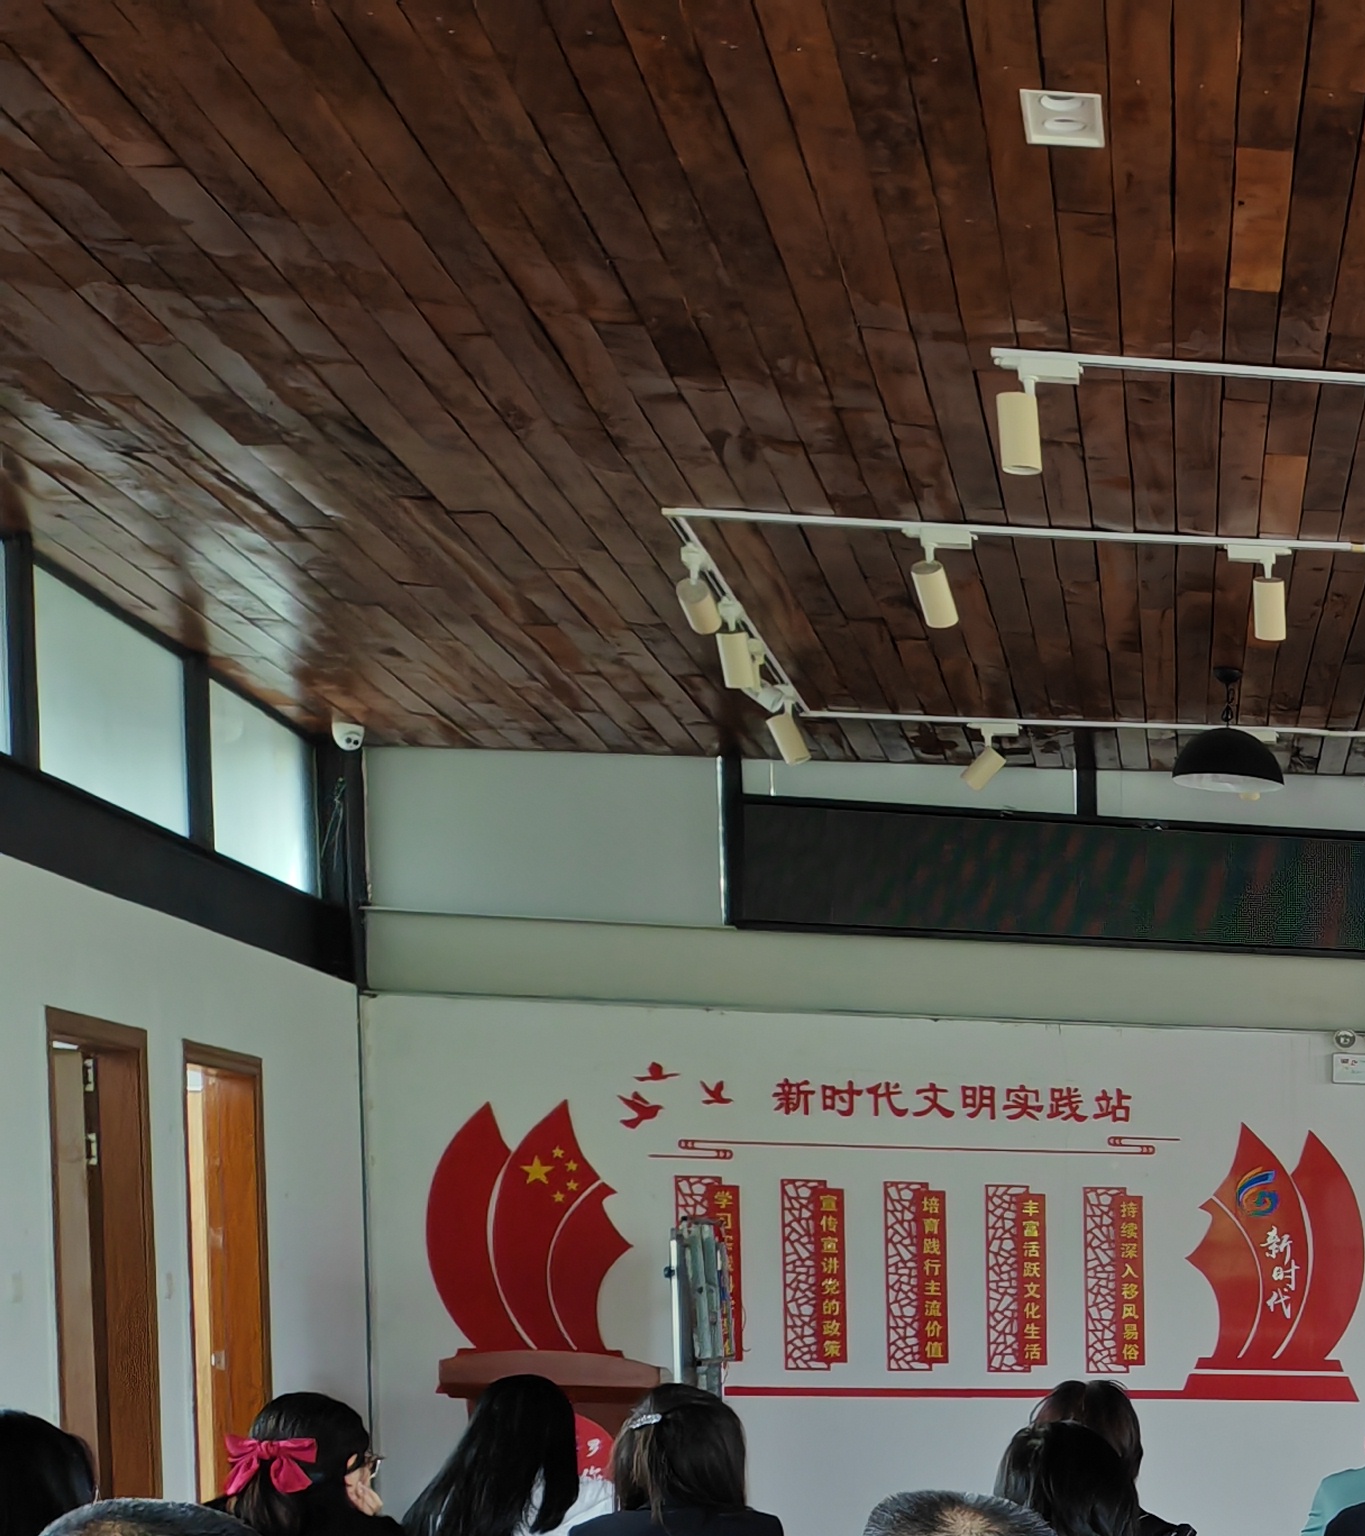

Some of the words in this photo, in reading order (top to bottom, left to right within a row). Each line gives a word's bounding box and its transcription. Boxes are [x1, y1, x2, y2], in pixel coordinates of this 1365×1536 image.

[772, 1078, 1132, 1123] 新时代文明实践站
[820, 1194, 842, 1358] 宣传宣讲党的政策
[921, 1195, 944, 1359] 培育践行主流价值
[1022, 1199, 1041, 1361] 丰富活跃文化生活
[1120, 1200, 1140, 1361] 持续深入移风易俗
[1260, 1225, 1300, 1319] 新时代
